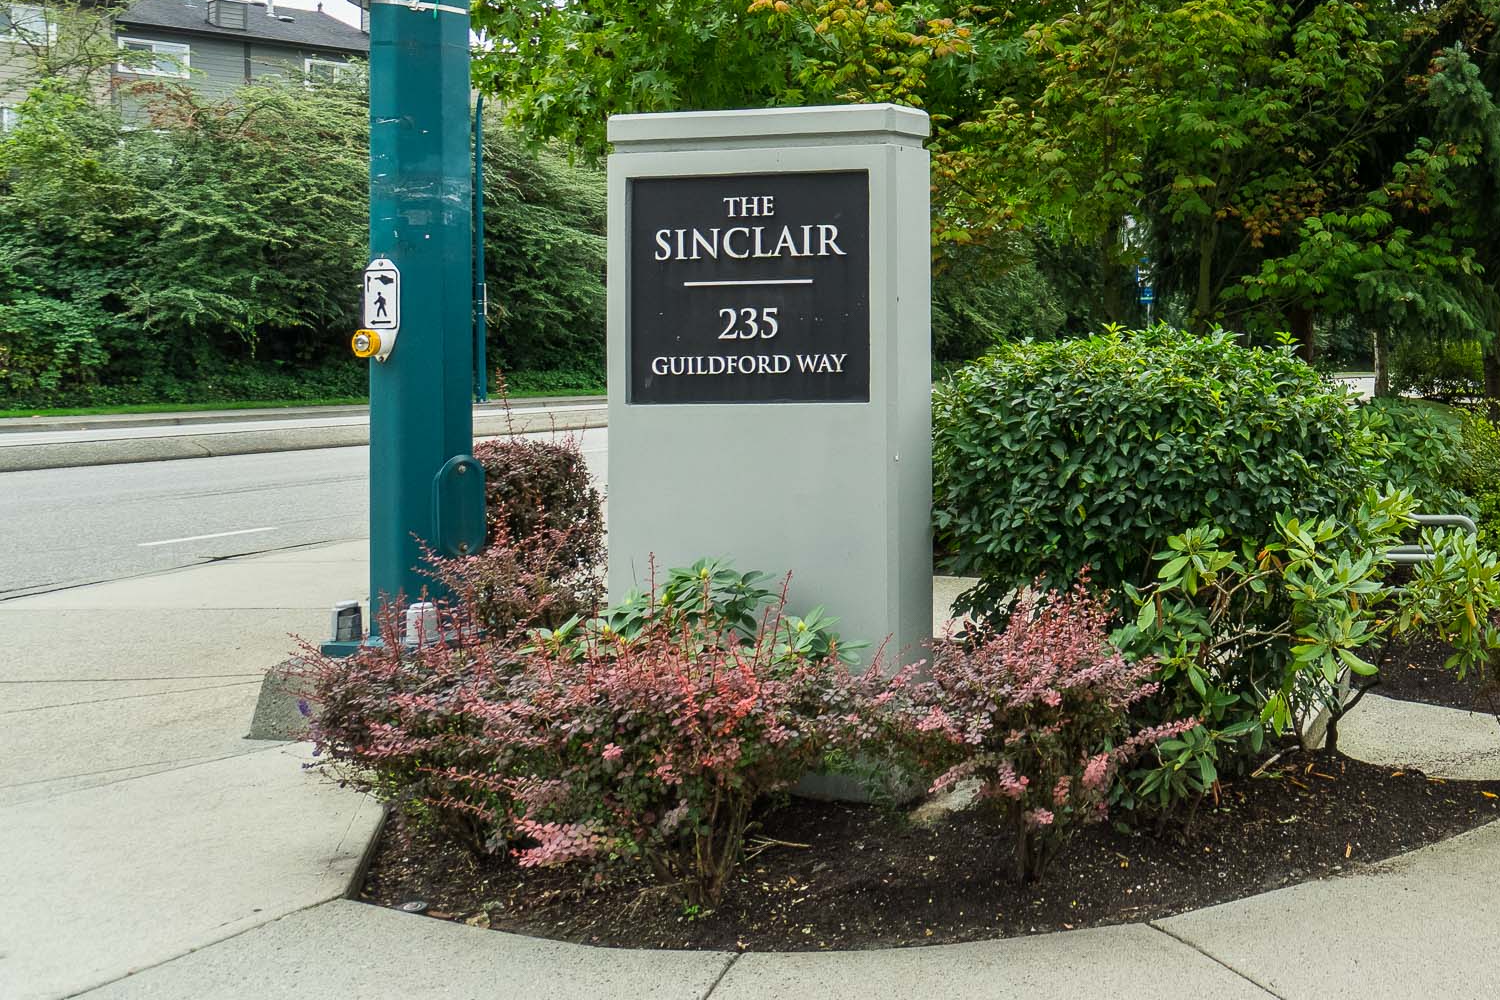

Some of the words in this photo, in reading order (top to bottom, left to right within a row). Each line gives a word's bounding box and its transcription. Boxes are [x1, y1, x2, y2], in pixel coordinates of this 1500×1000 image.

[723, 195, 775, 217] THE
[654, 224, 847, 260] SINCLAIR
[717, 307, 779, 340] 235
[651, 354, 791, 375] GUILDFORD
[796, 353, 847, 373] WAY
